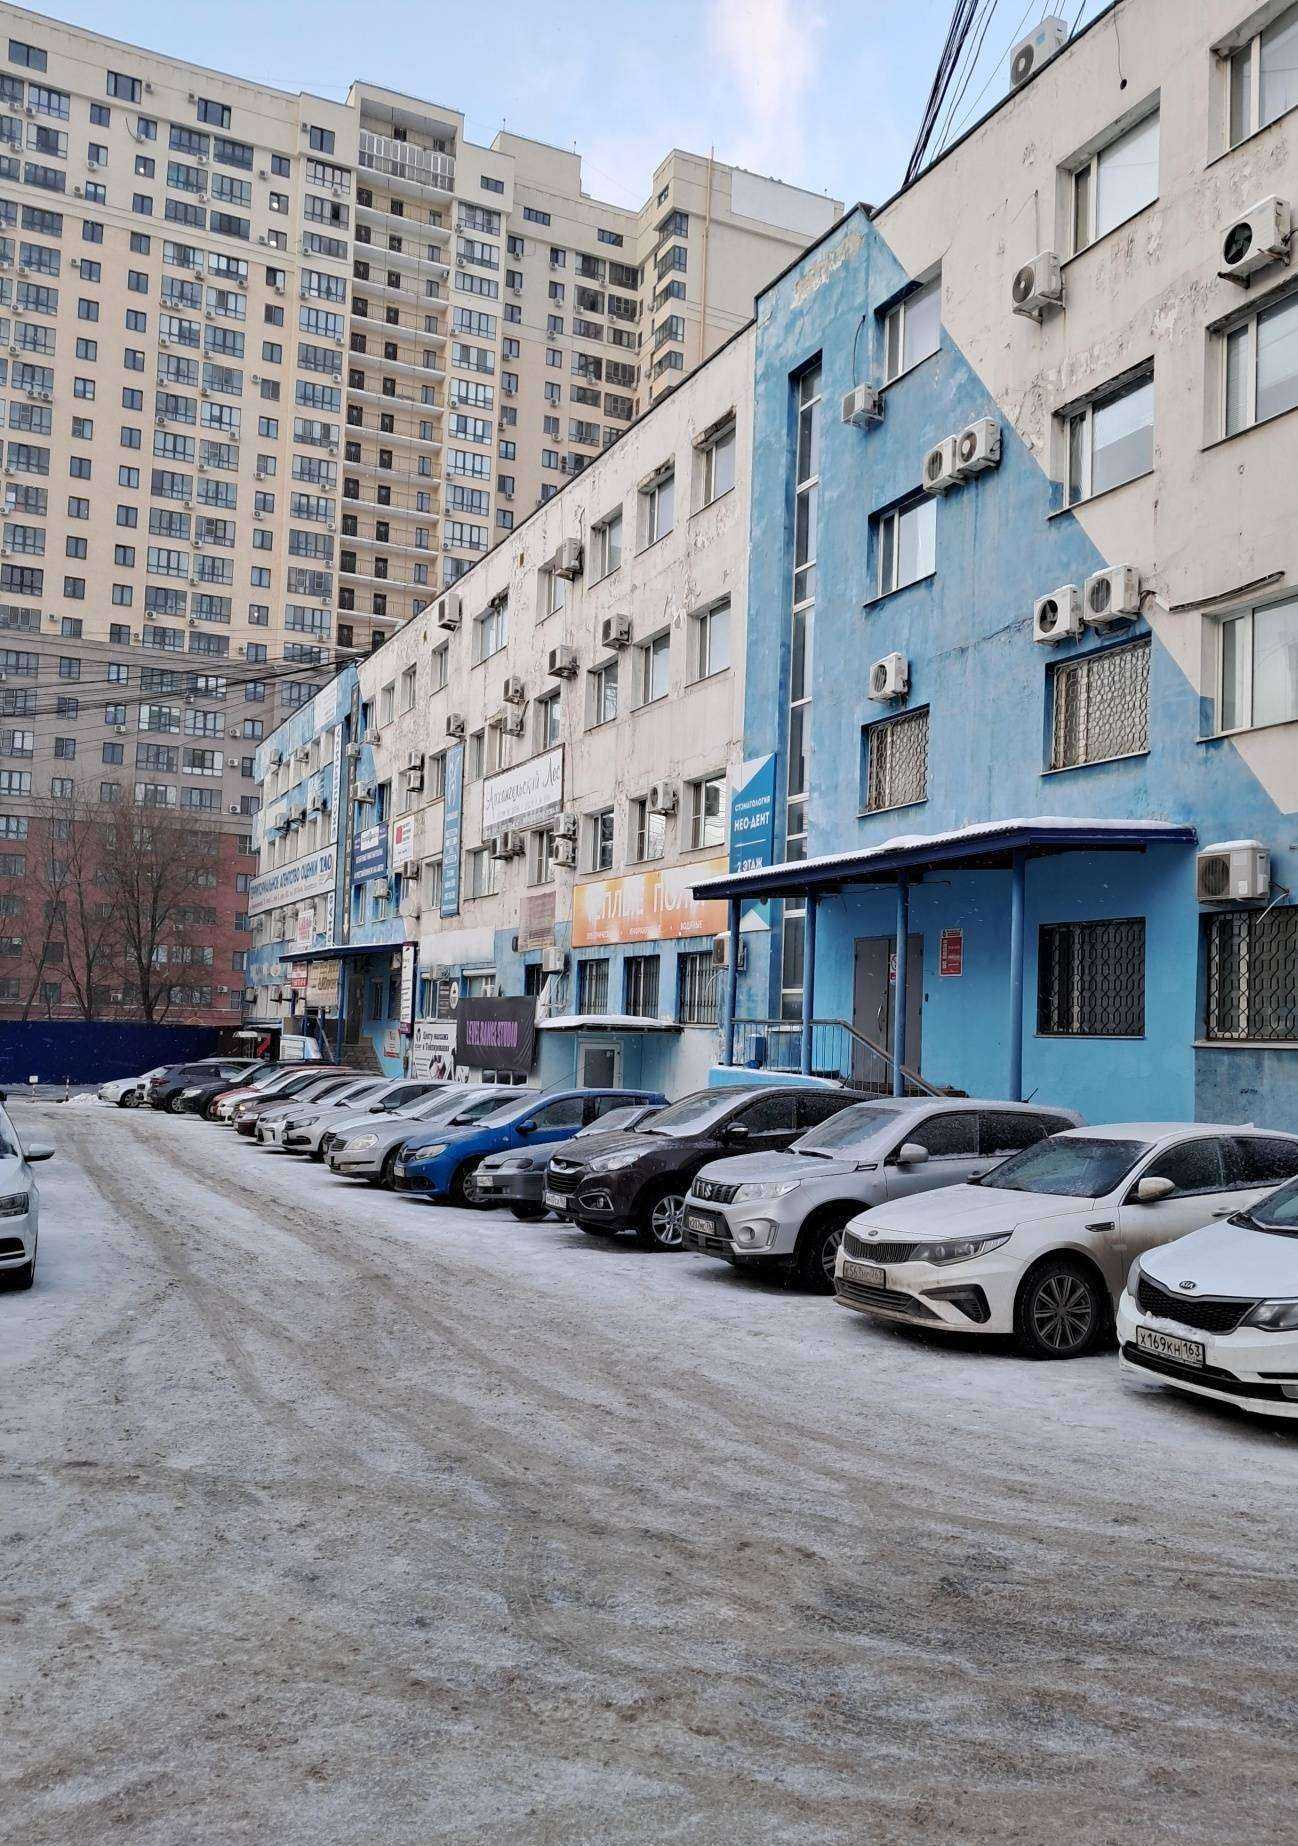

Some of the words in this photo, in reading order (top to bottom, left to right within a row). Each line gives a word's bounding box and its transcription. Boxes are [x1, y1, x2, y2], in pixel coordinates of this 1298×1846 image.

[543, 757, 561, 789] Лес
[734, 795, 771, 812] СТОМАТОЛОГИЯ
[733, 811, 770, 832] НЕО-ДЕНТ
[742, 856, 763, 872] ЭТАЖ
[1140, 1332, 1180, 1356] Х169КН
[1183, 1342, 1201, 1357] 163
